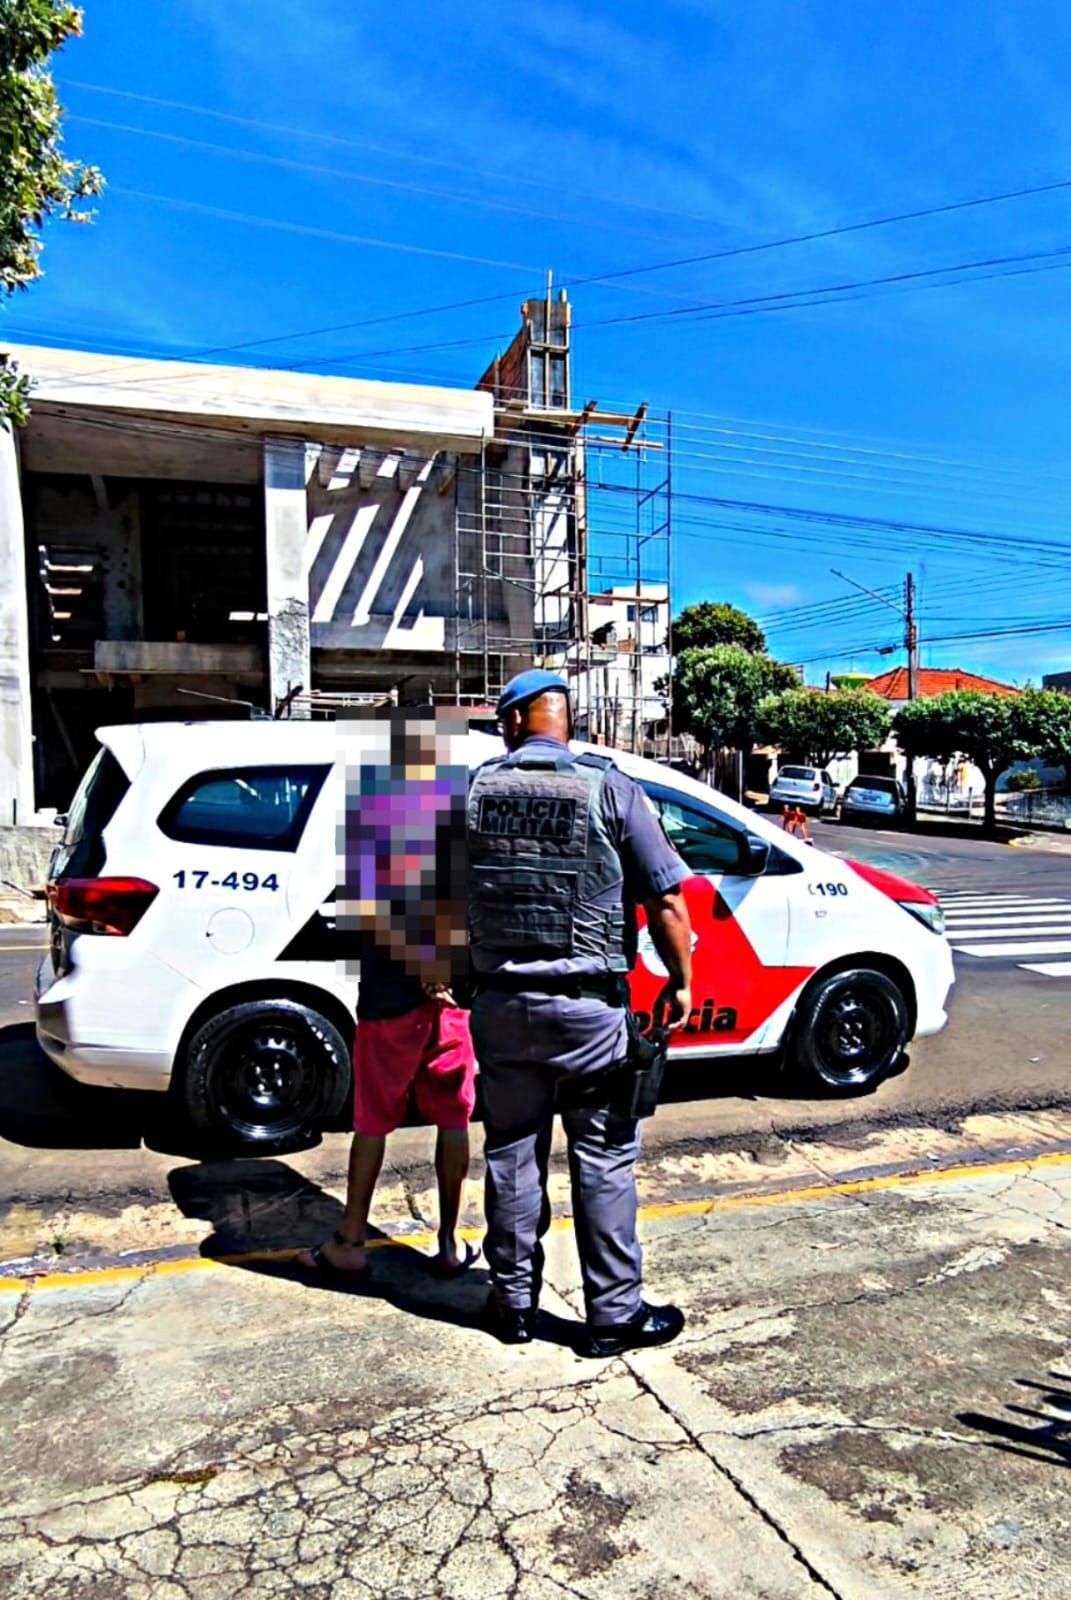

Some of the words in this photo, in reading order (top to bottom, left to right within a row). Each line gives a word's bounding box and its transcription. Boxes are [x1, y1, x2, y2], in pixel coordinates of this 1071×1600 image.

[481, 814, 572, 837] MILITAR
[173, 869, 279, 892] 17-494
[816, 882, 848, 896] 190
